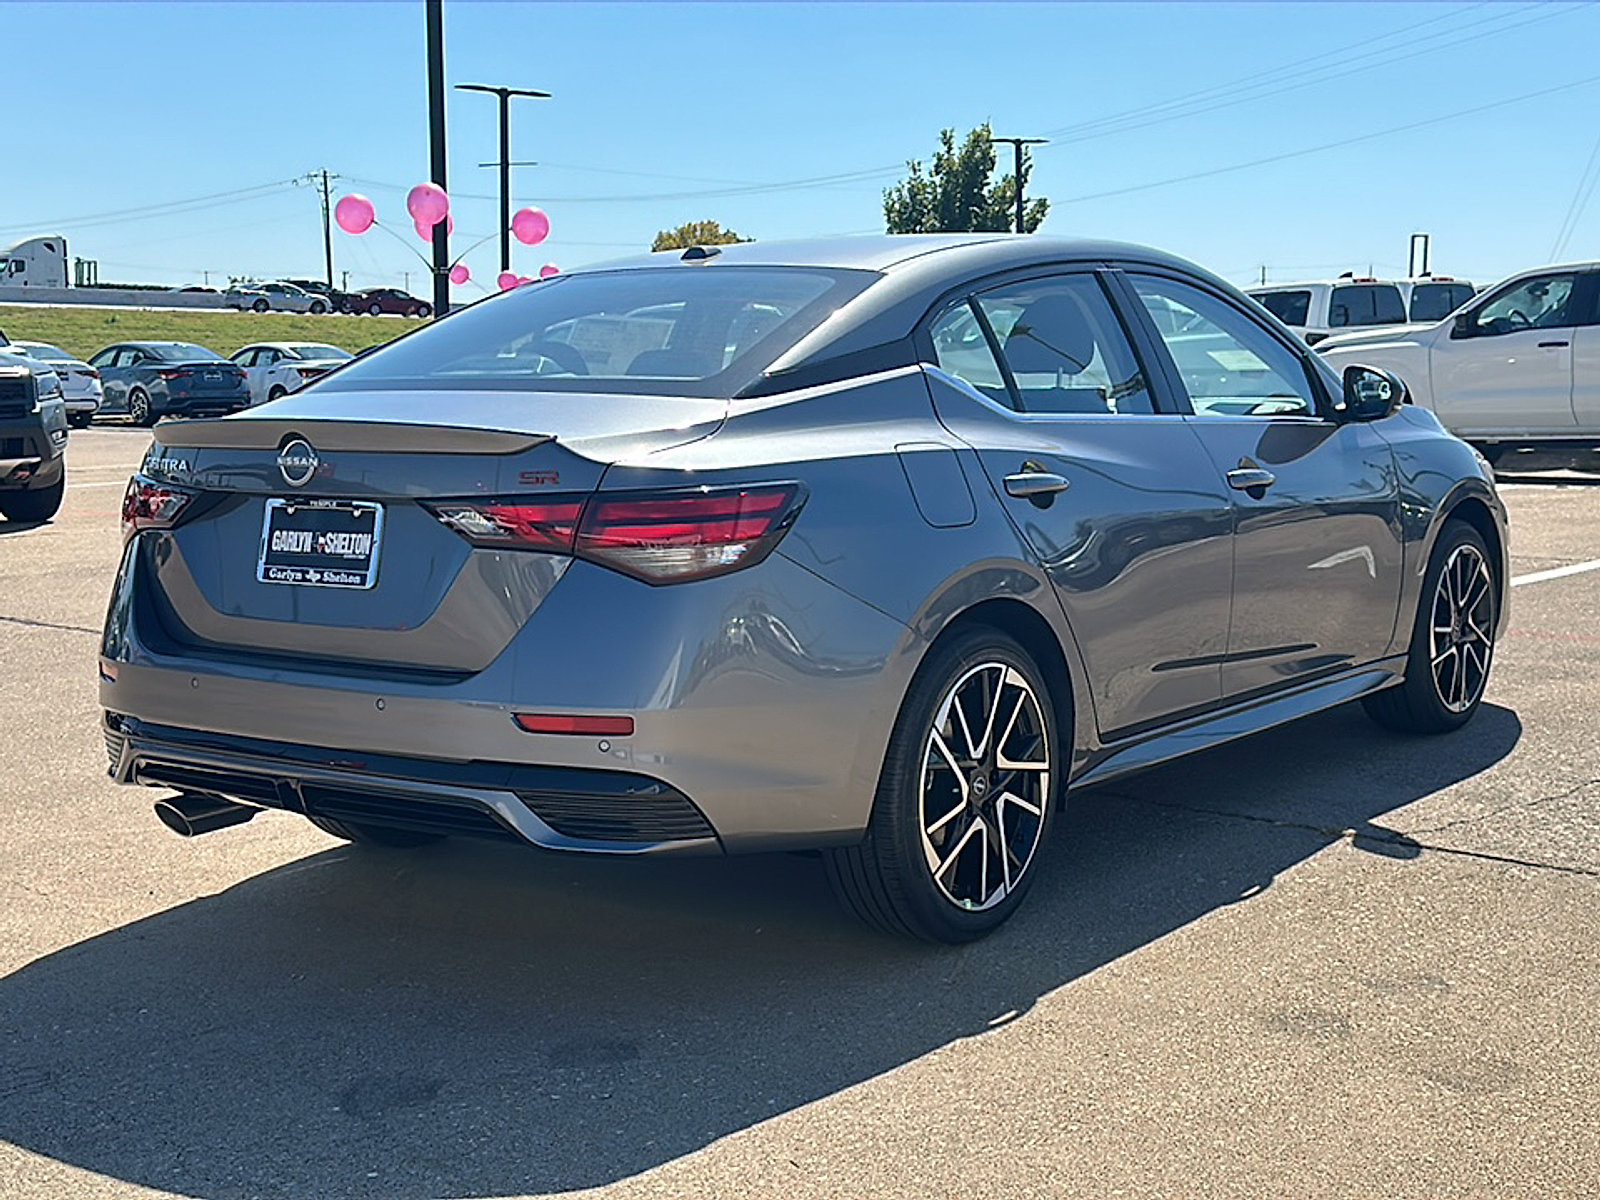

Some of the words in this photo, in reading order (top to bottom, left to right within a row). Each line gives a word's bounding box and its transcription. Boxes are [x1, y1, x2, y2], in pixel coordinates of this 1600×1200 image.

[276, 456, 318, 467] NISSAN
[519, 470, 560, 485] SR
[272, 530, 313, 553] GARLYN
[325, 532, 372, 554] SHELTON
[322, 571, 361, 584] Shelton
